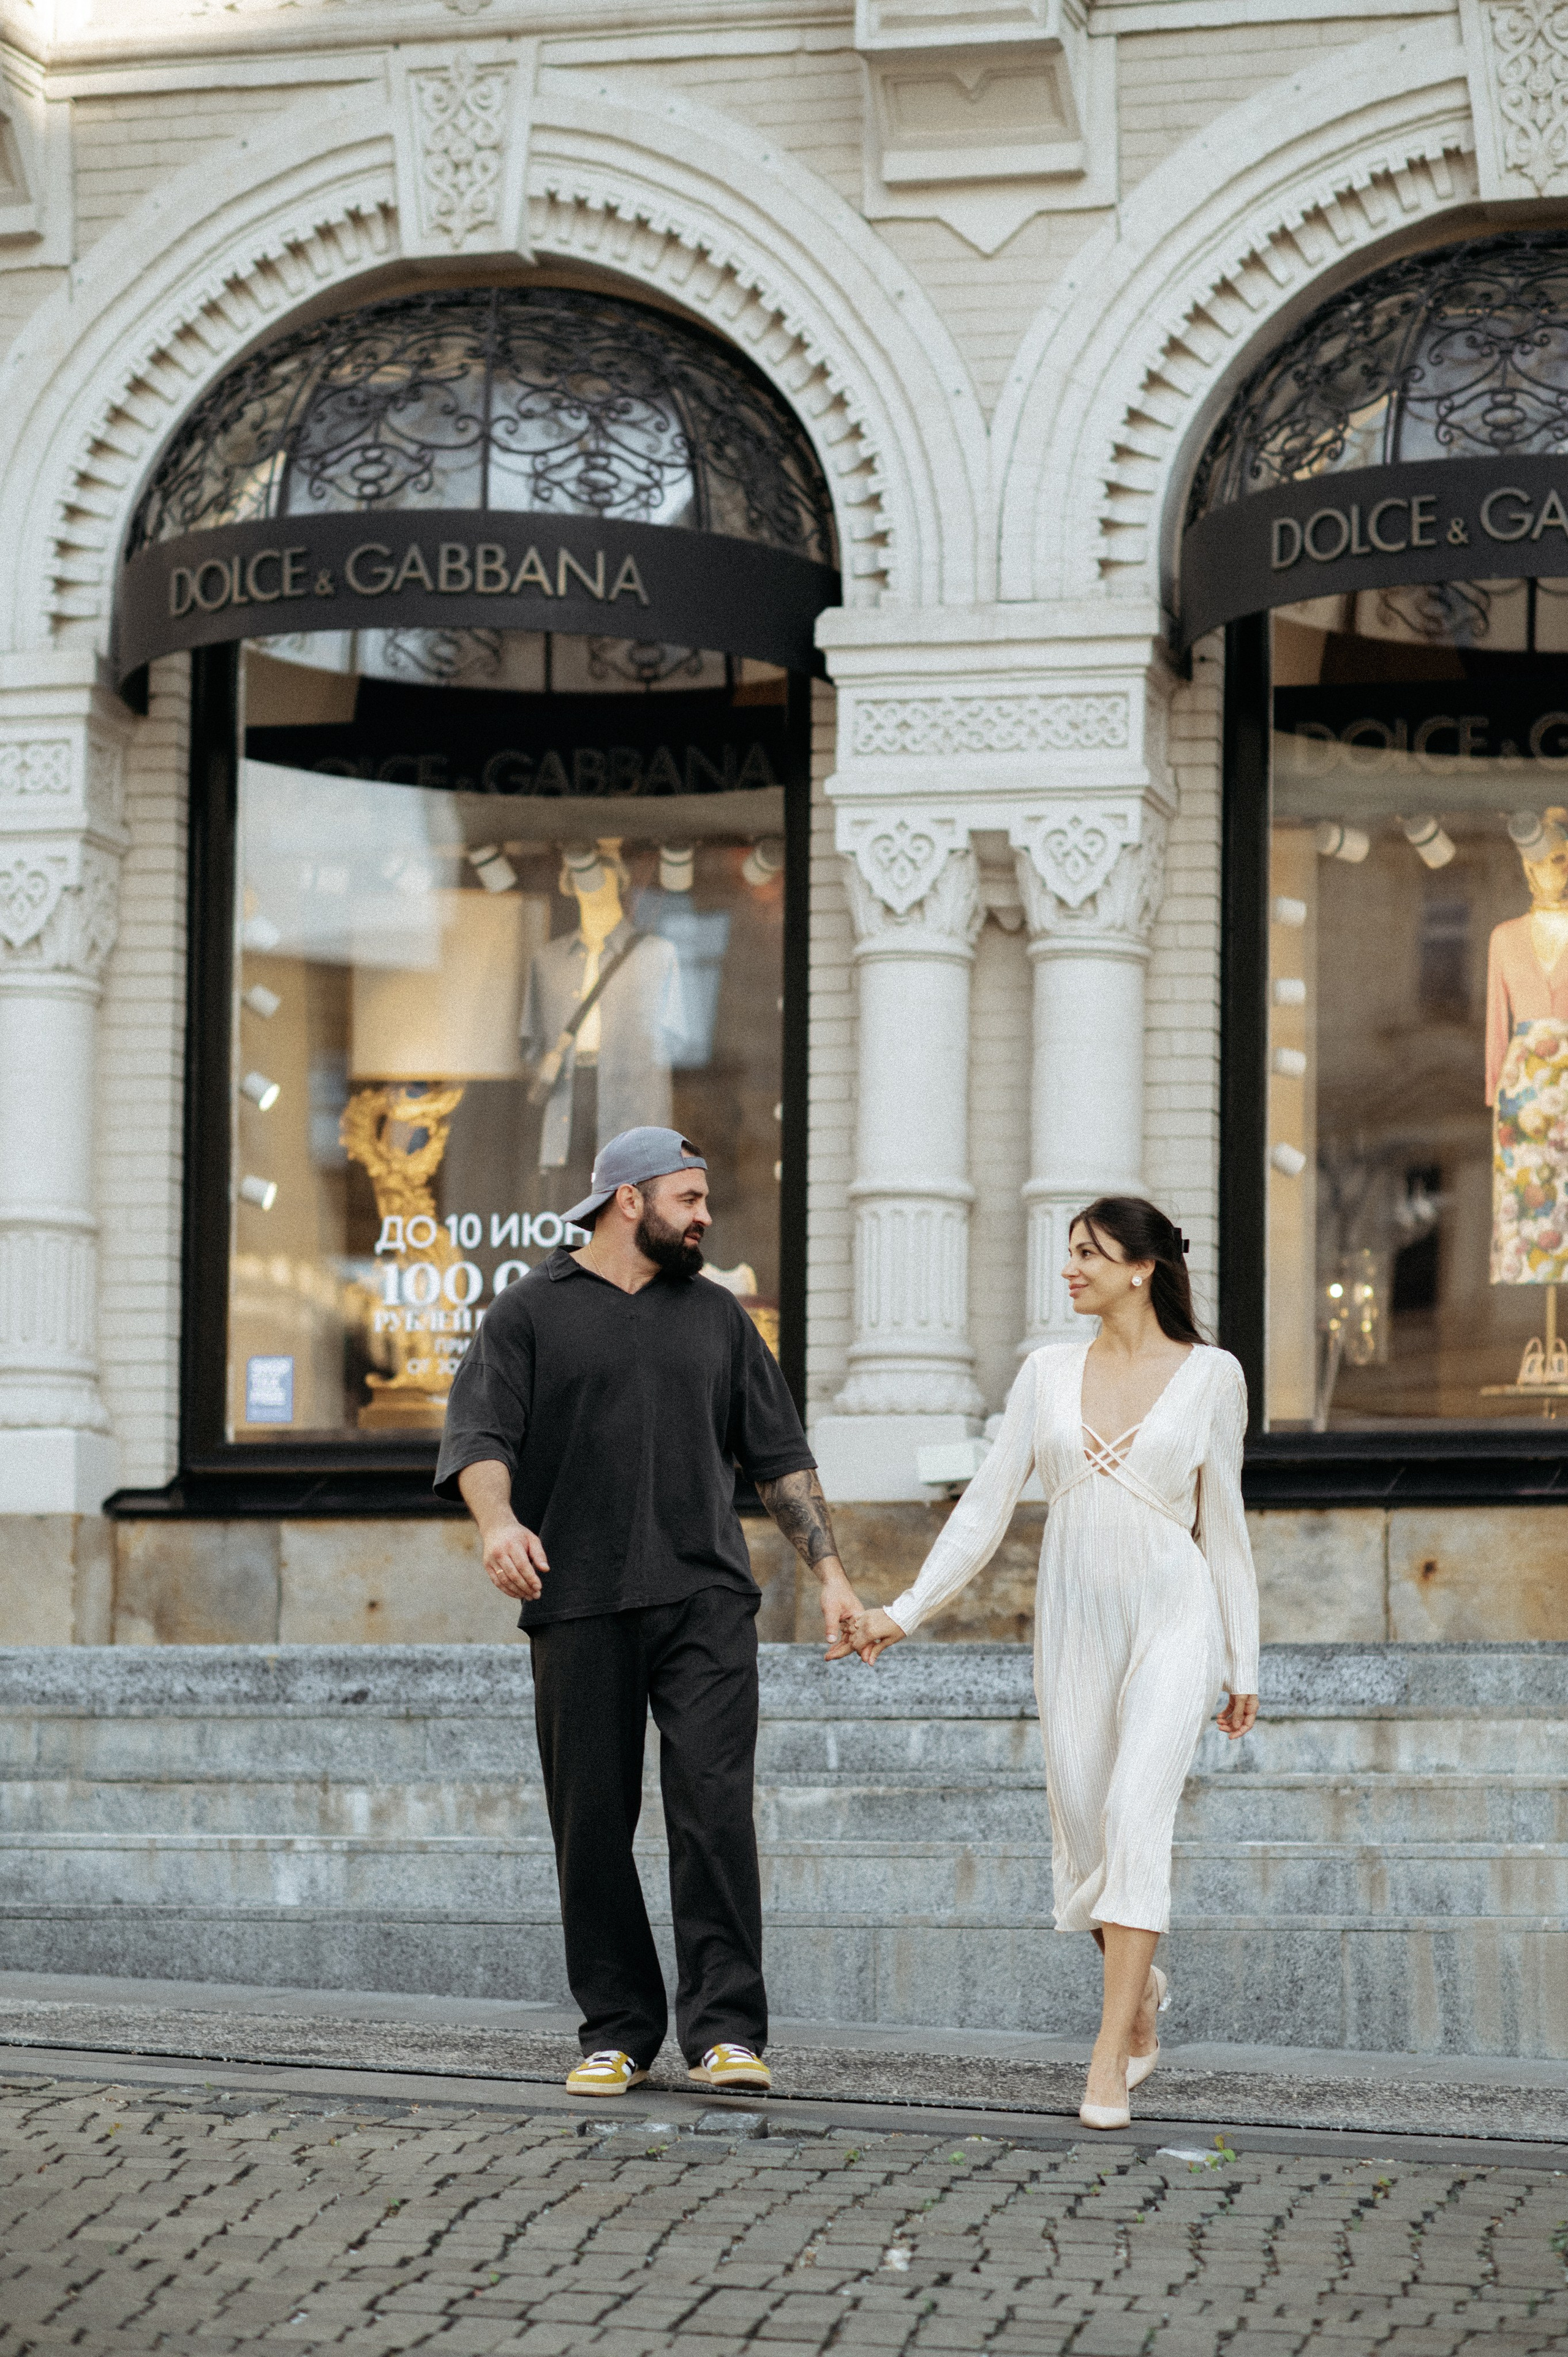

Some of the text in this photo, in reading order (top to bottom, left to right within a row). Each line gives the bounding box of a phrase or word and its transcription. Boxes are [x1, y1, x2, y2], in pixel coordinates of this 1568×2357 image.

[1272, 487, 1568, 570] DOLCE & GA
[170, 542, 650, 616] DOLCE & GABBANA
[374, 1211, 592, 1255] ДО 10 ИЮН
[382, 1261, 484, 1307] 100
